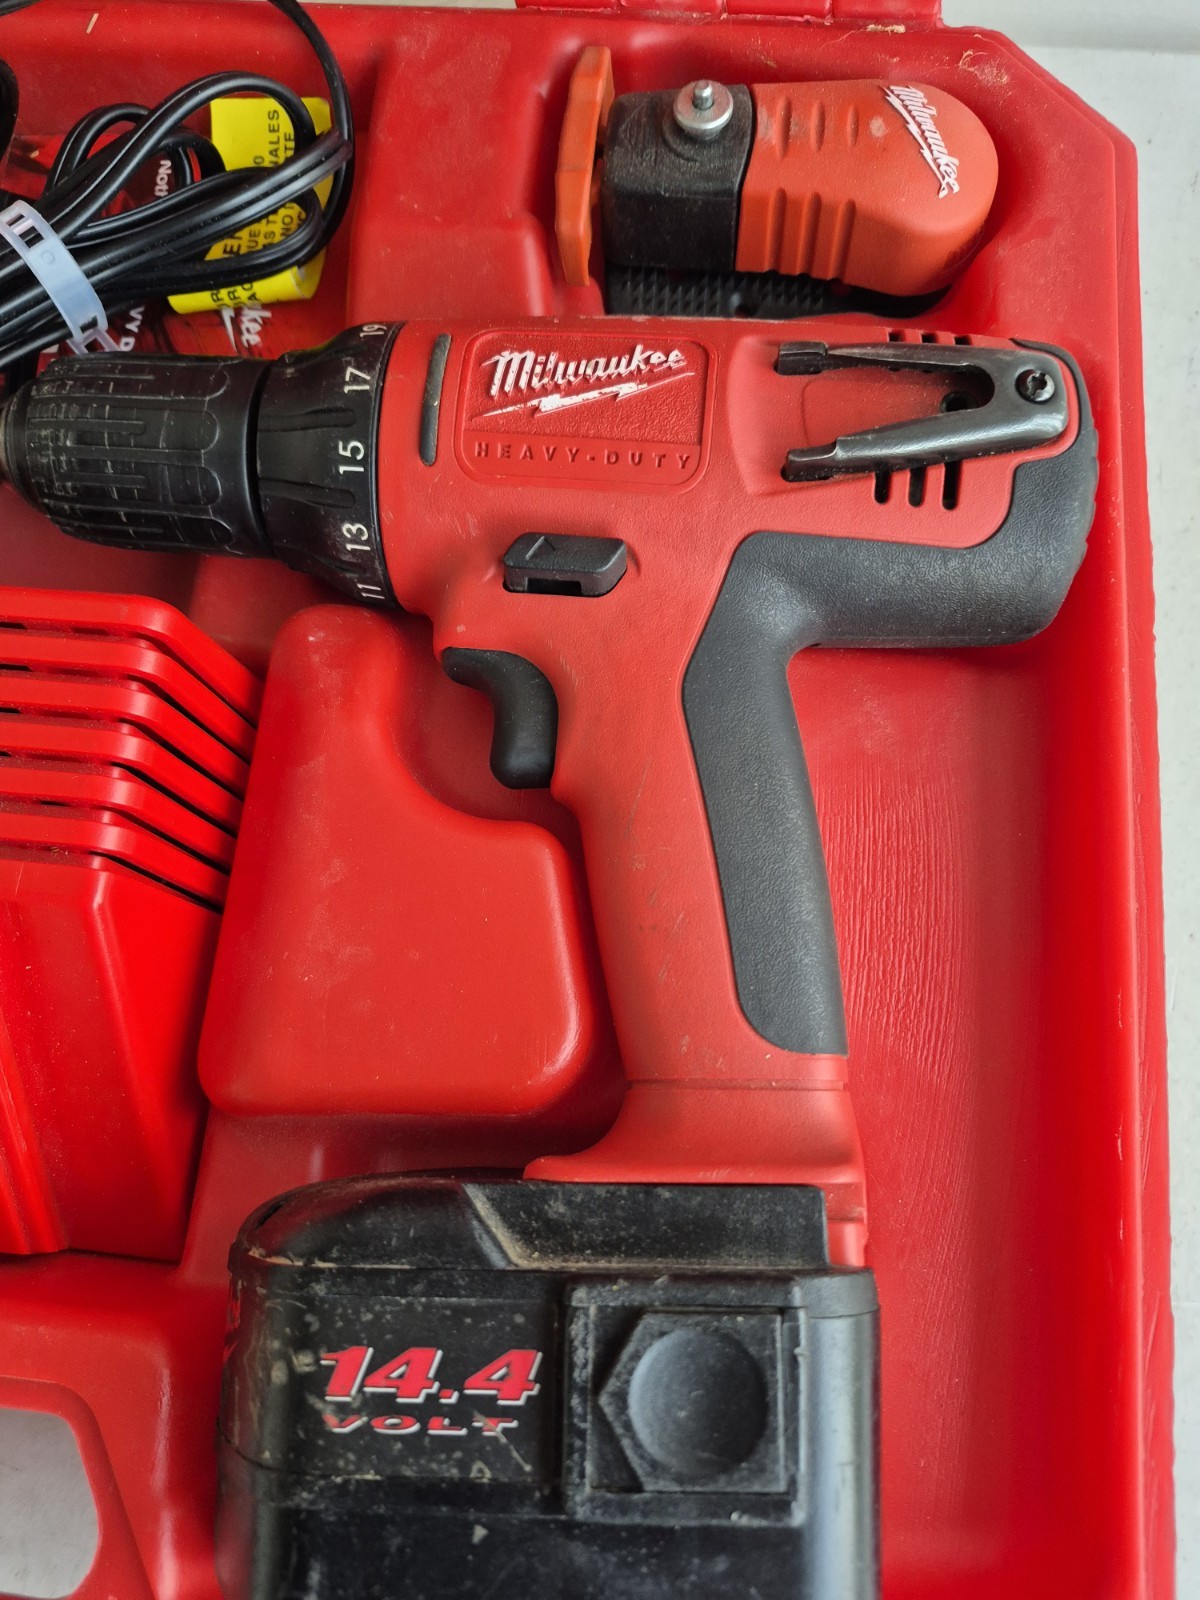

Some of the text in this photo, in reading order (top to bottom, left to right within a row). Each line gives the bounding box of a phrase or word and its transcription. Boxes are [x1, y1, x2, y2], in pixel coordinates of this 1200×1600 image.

[887, 85, 960, 198] Milwaukee
[360, 323, 387, 338] 19
[343, 366, 371, 394] 17
[482, 344, 687, 398] Milwaukee
[338, 440, 365, 474] 15
[342, 522, 371, 551] 13
[356, 583, 385, 600] 11
[319, 1345, 543, 1406] 14.4
[322, 1414, 520, 1437] VOLT
